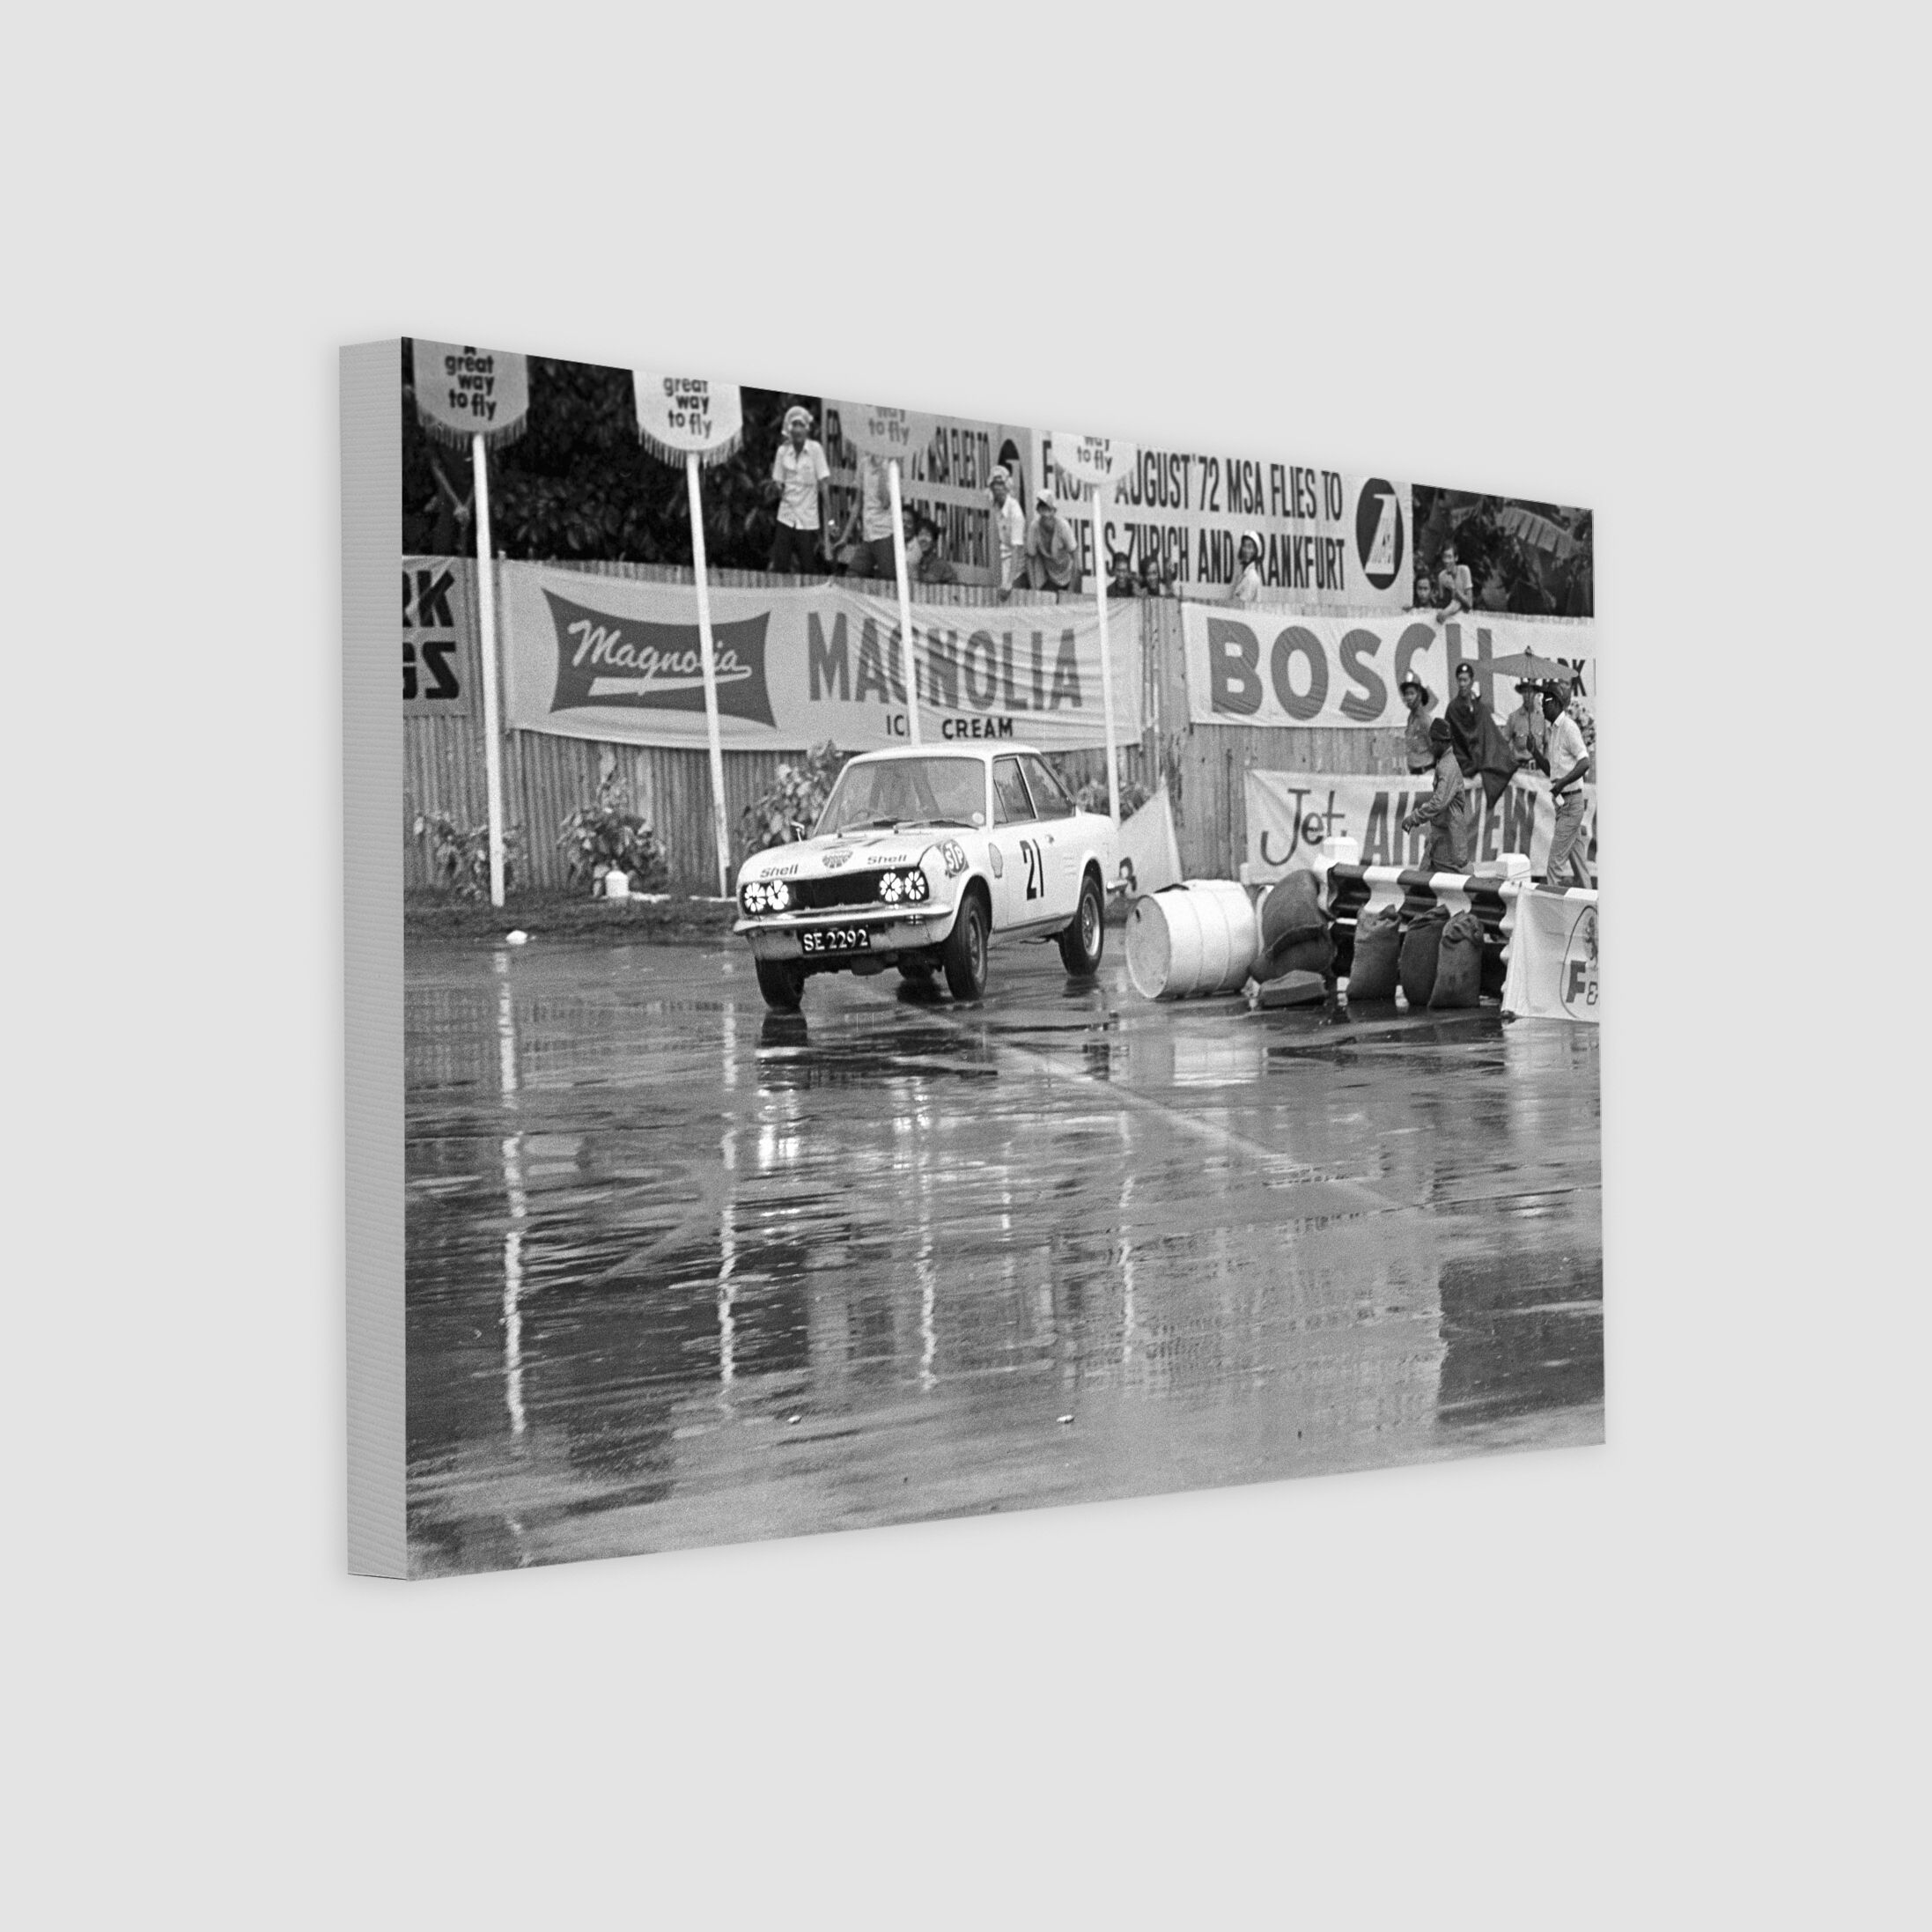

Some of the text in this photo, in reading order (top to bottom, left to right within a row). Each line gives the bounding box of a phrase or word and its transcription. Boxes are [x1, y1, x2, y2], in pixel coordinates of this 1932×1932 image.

[445, 355, 494, 375] great
[458, 374, 495, 395] way
[664, 377, 708, 397] great
[449, 388, 497, 421] to fly
[675, 395, 710, 415] way
[668, 409, 712, 439] to fly
[868, 418, 910, 446] to fly
[1077, 446, 1113, 474] to fly
[1227, 458, 1265, 515] MSA
[1271, 463, 1316, 519] FLIES
[1322, 471, 1343, 520] TO
[1198, 528, 1234, 584] AND
[1254, 532, 1345, 590] RANKFURT
[567, 620, 752, 696] Magnoia
[807, 612, 1081, 710] MAGNOLIA
[1207, 616, 1495, 722] BOSCH
[886, 715, 1013, 740] IC CREAM
[867, 854, 907, 866] Shell
[945, 843, 964, 870] STP
[1019, 839, 1044, 901] 21
[760, 864, 799, 878] Shell
[803, 929, 868, 952] SE 2292
